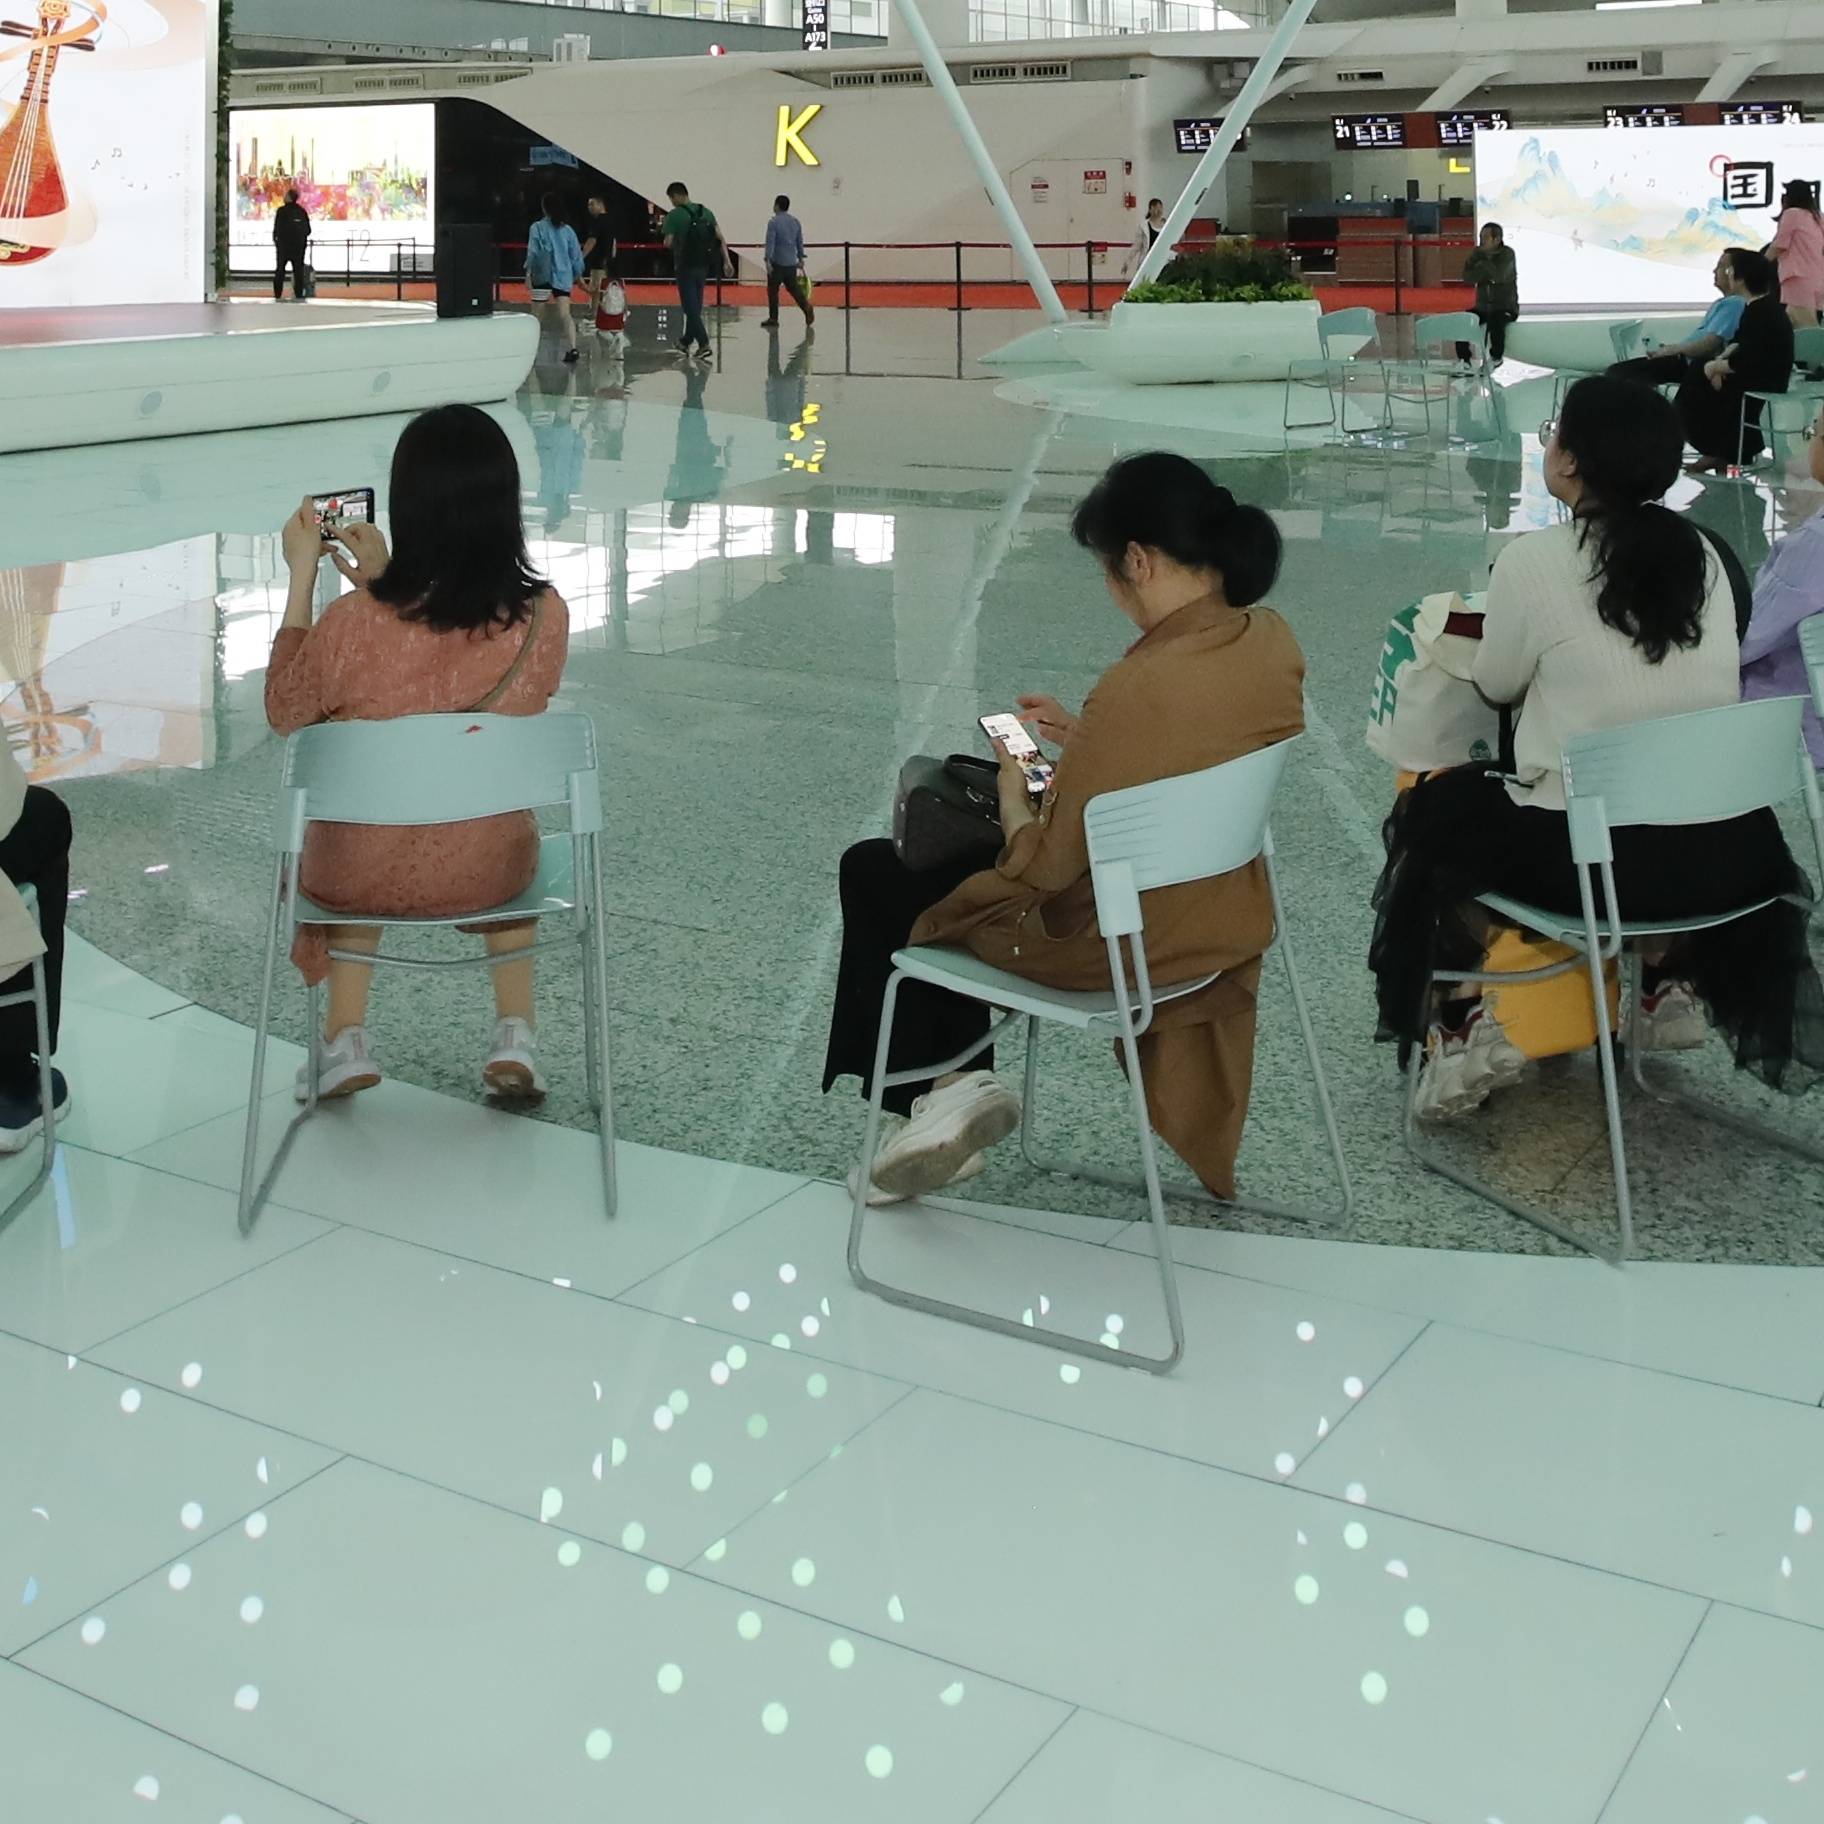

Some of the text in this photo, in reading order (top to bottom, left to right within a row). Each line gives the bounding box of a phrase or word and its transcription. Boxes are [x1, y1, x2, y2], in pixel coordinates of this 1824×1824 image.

[805, 13, 825, 25] A50
[804, 31, 826, 43] A173
[1607, 116, 1624, 128] 23
[1782, 112, 1801, 124] 24
[773, 104, 823, 167] K
[1336, 125, 1350, 138] 21
[347, 229, 371, 262] T2
